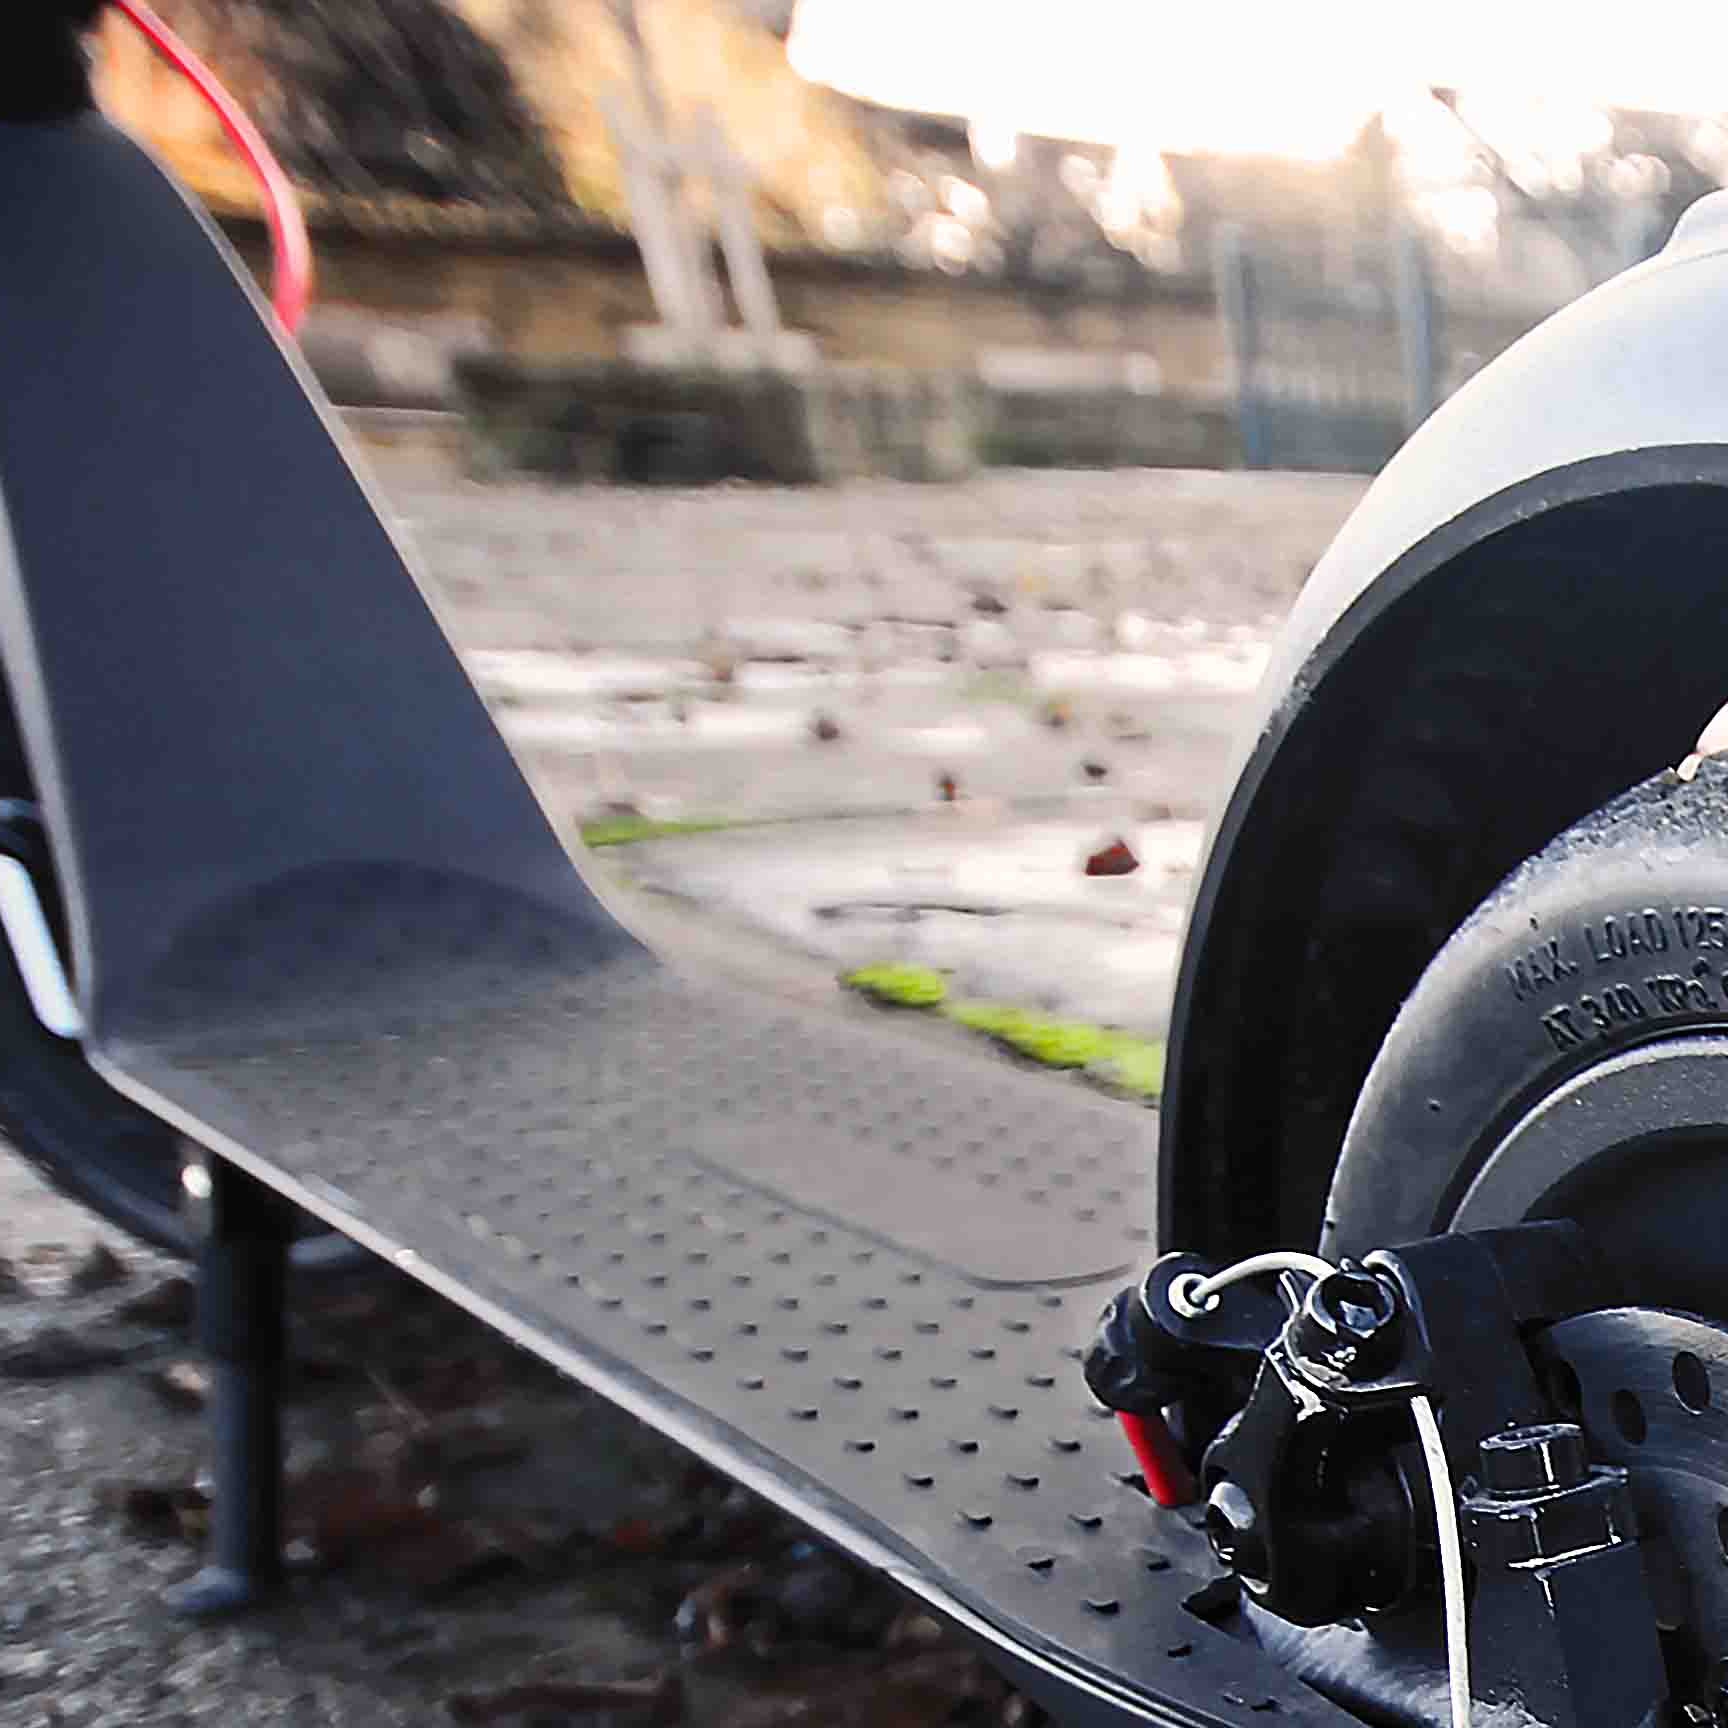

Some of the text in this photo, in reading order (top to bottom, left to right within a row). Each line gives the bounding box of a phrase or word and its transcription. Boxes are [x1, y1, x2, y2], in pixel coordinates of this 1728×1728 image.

[1584, 907, 1668, 964] LOAD
[1542, 1003, 1585, 1053] AT
[1579, 983, 1648, 1038] 340
